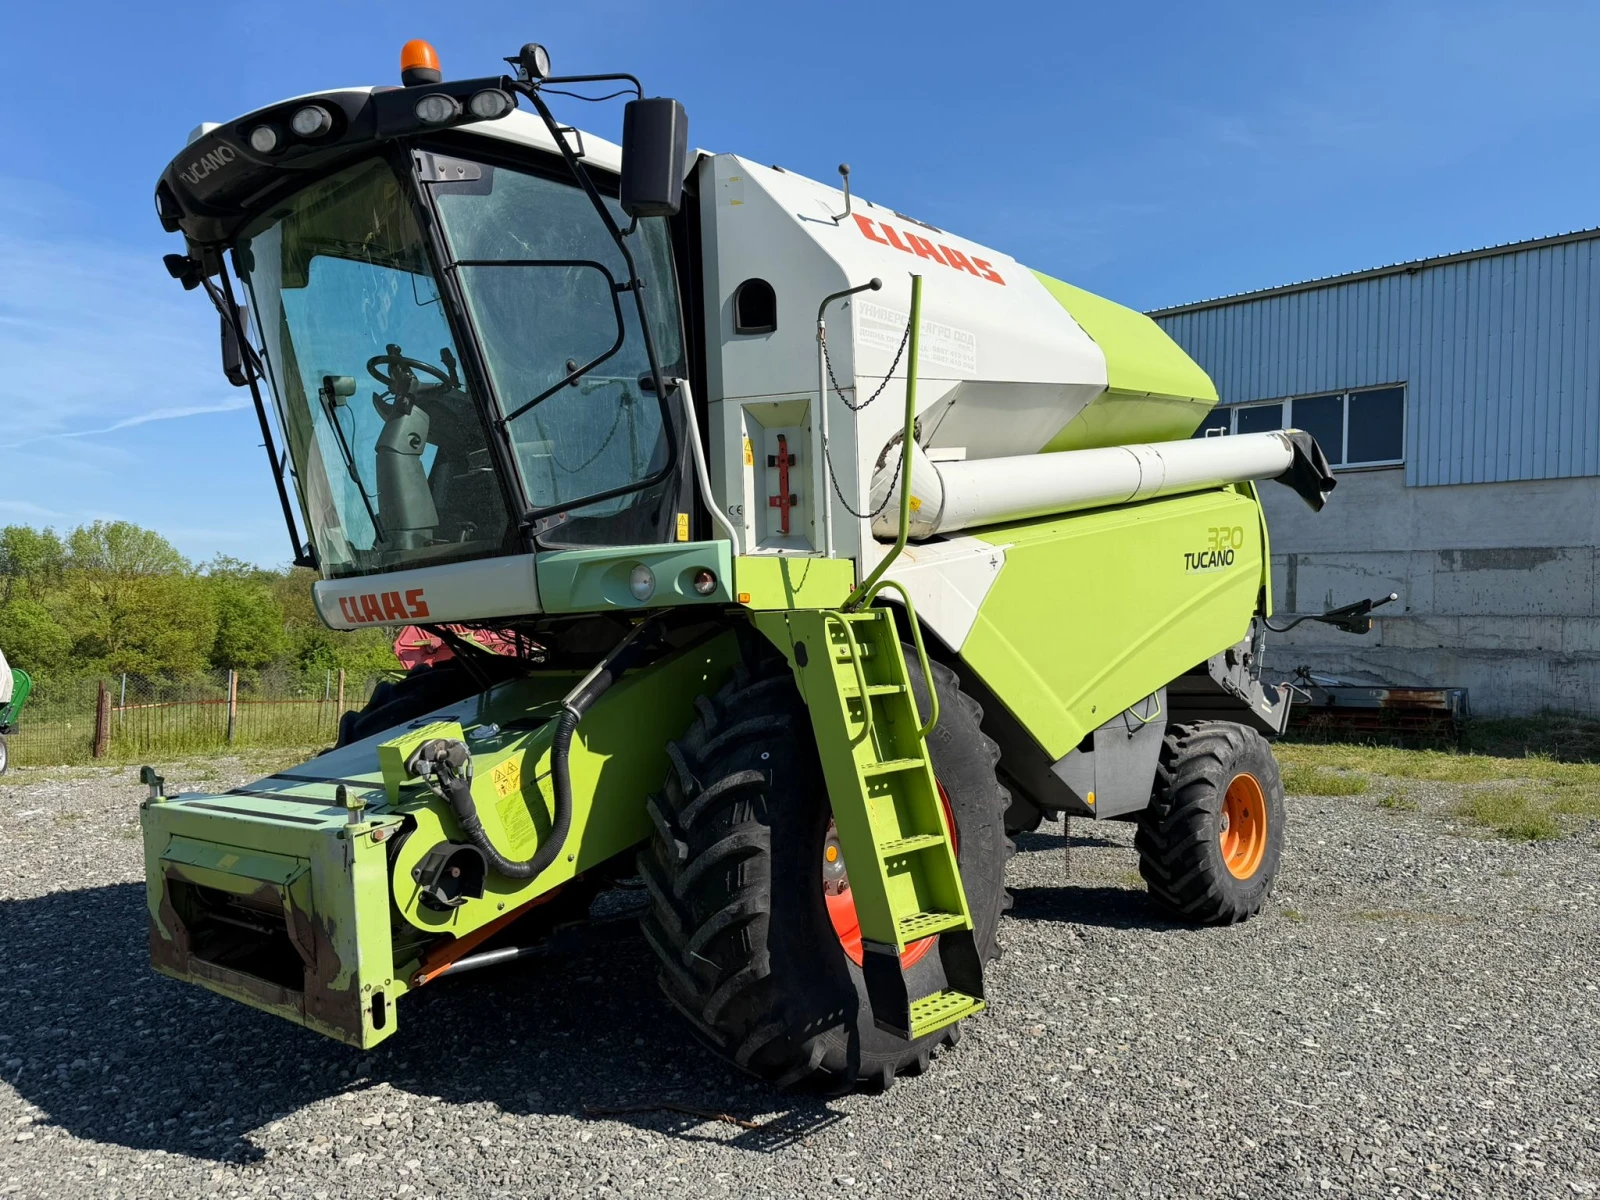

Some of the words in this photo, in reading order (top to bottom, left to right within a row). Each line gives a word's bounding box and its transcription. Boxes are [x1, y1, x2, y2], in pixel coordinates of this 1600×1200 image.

[851, 212, 1006, 286] CLAAS
[1207, 526, 1244, 551] 320
[1184, 549, 1235, 570] TUCANO
[338, 588, 430, 623] CLAAS
